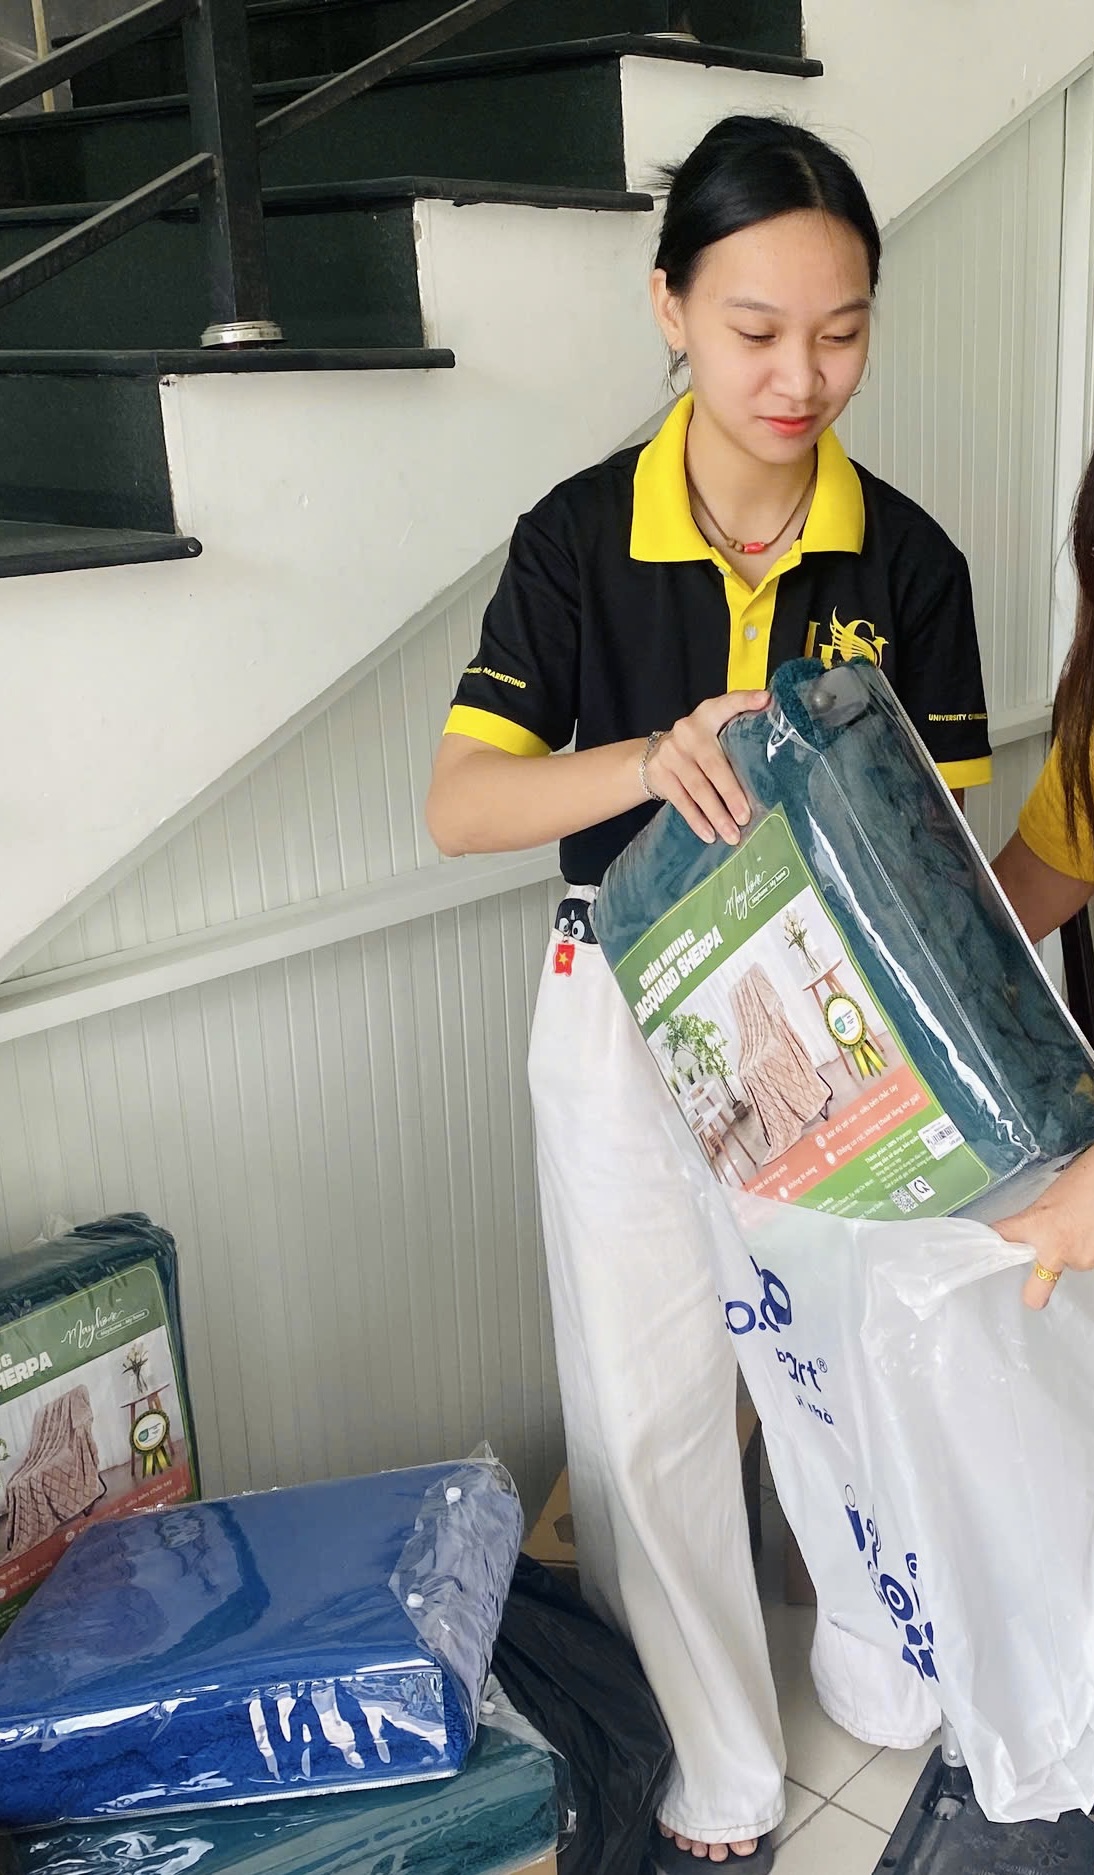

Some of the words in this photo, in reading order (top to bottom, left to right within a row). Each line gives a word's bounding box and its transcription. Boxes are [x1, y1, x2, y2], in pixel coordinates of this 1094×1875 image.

[928, 713, 967, 722] UNIVERSITY
[660, 929, 696, 969] NHUNG
[634, 966, 681, 1026] JACQUARD
[676, 925, 724, 978] SHERPA
